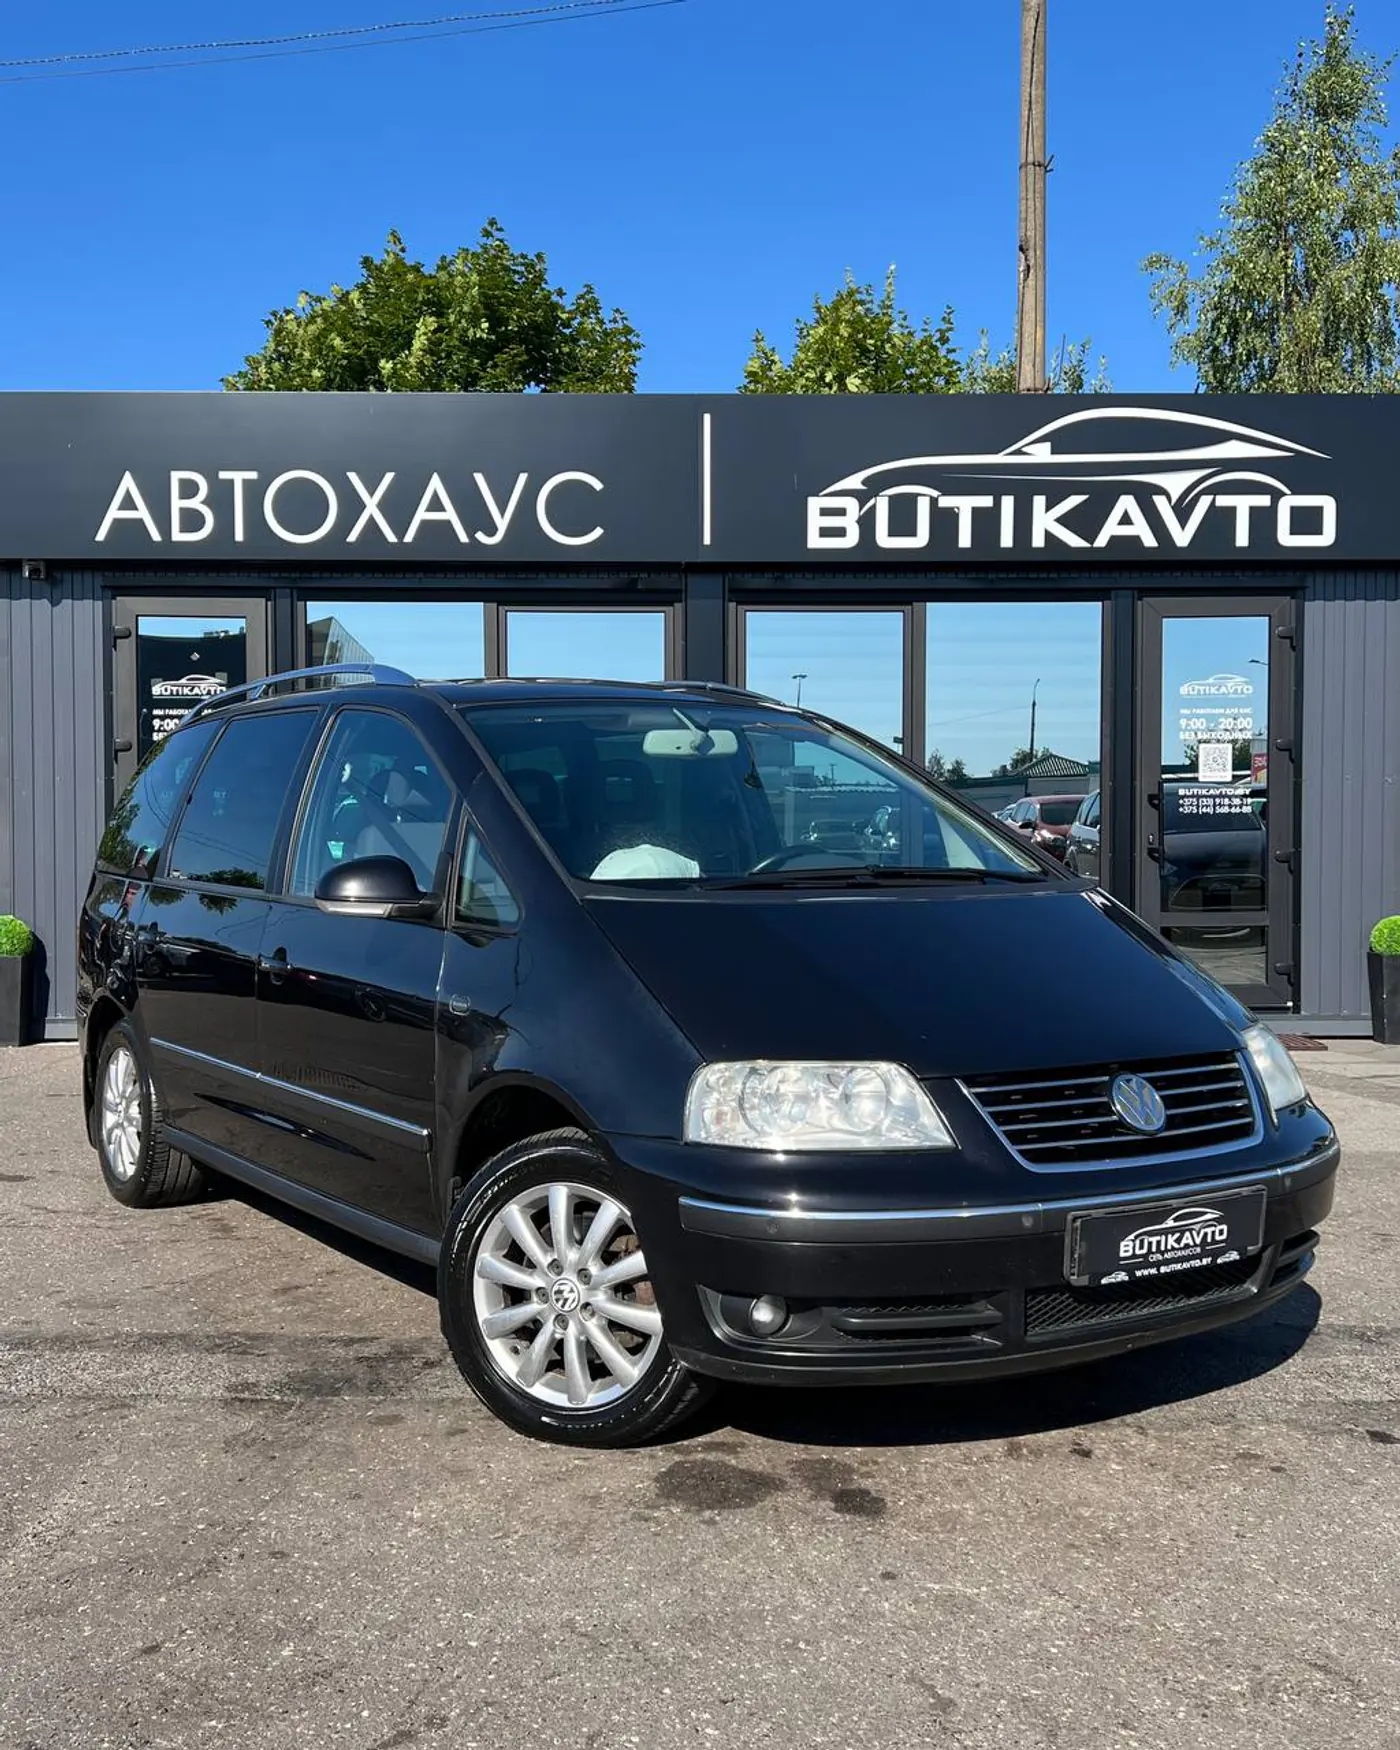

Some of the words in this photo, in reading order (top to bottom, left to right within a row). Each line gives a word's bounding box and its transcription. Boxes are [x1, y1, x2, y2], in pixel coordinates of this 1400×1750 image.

[94, 469, 605, 546] АВТОХАУС
[806, 493, 1338, 549] BUTIKAVTO
[1180, 686, 1253, 695] BUTIKAVTO
[1180, 718, 1206, 730] 9:00
[1218, 718, 1253, 729] 20:00
[1178, 797, 1198, 806] +375
[1178, 805, 1198, 814] +375
[1119, 1224, 1228, 1258] BUTIKAVTO
